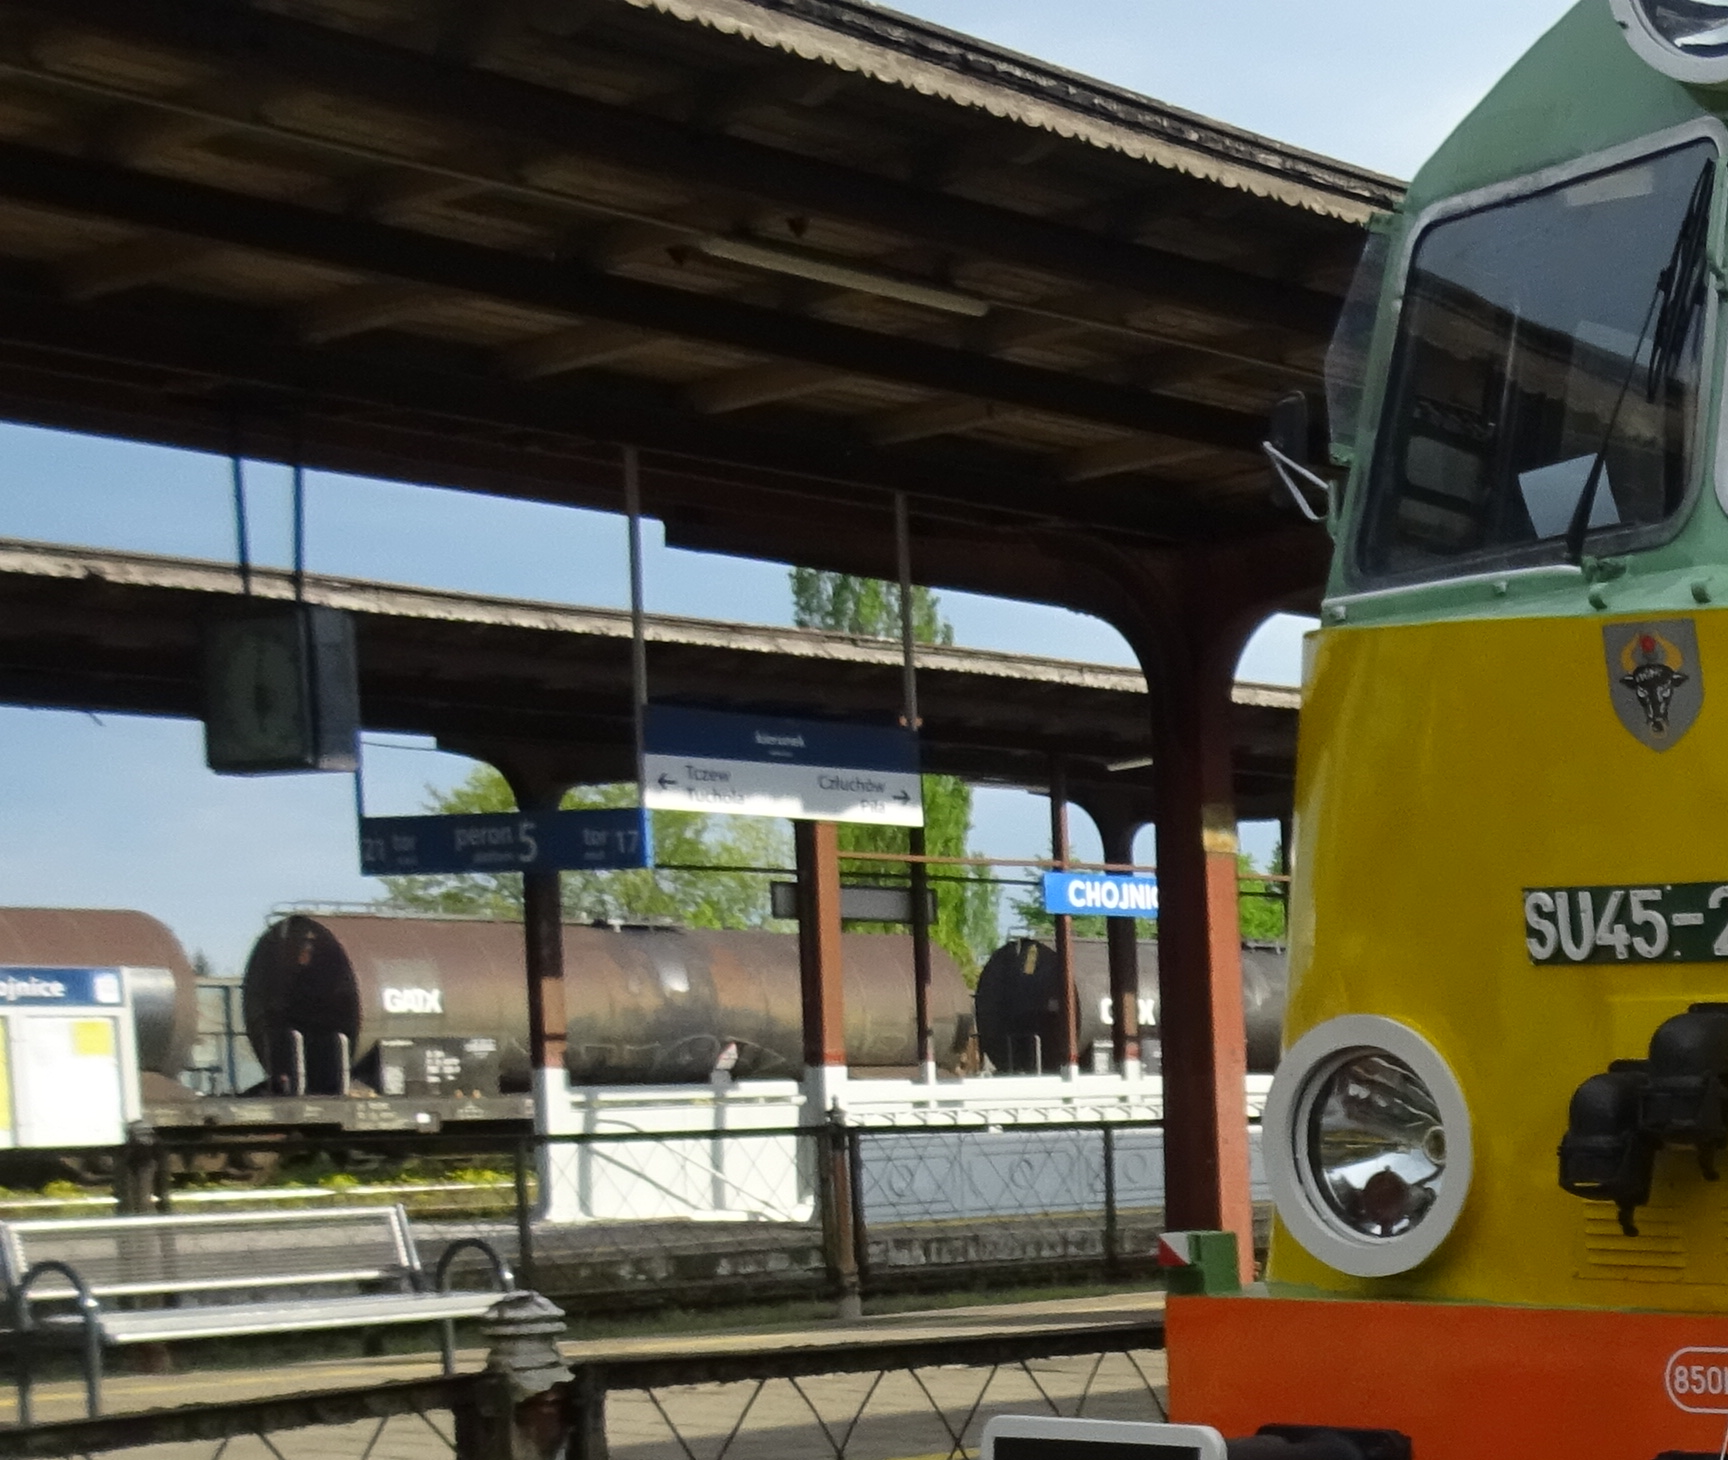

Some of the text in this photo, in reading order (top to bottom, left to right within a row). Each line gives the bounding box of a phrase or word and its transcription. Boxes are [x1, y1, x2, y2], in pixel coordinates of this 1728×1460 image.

[685, 765, 732, 783] Tczew
[817, 775, 886, 794] Człuchów
[454, 820, 538, 863] peron 5
[583, 828, 640, 854] tor 17
[383, 987, 443, 1014] GATX
